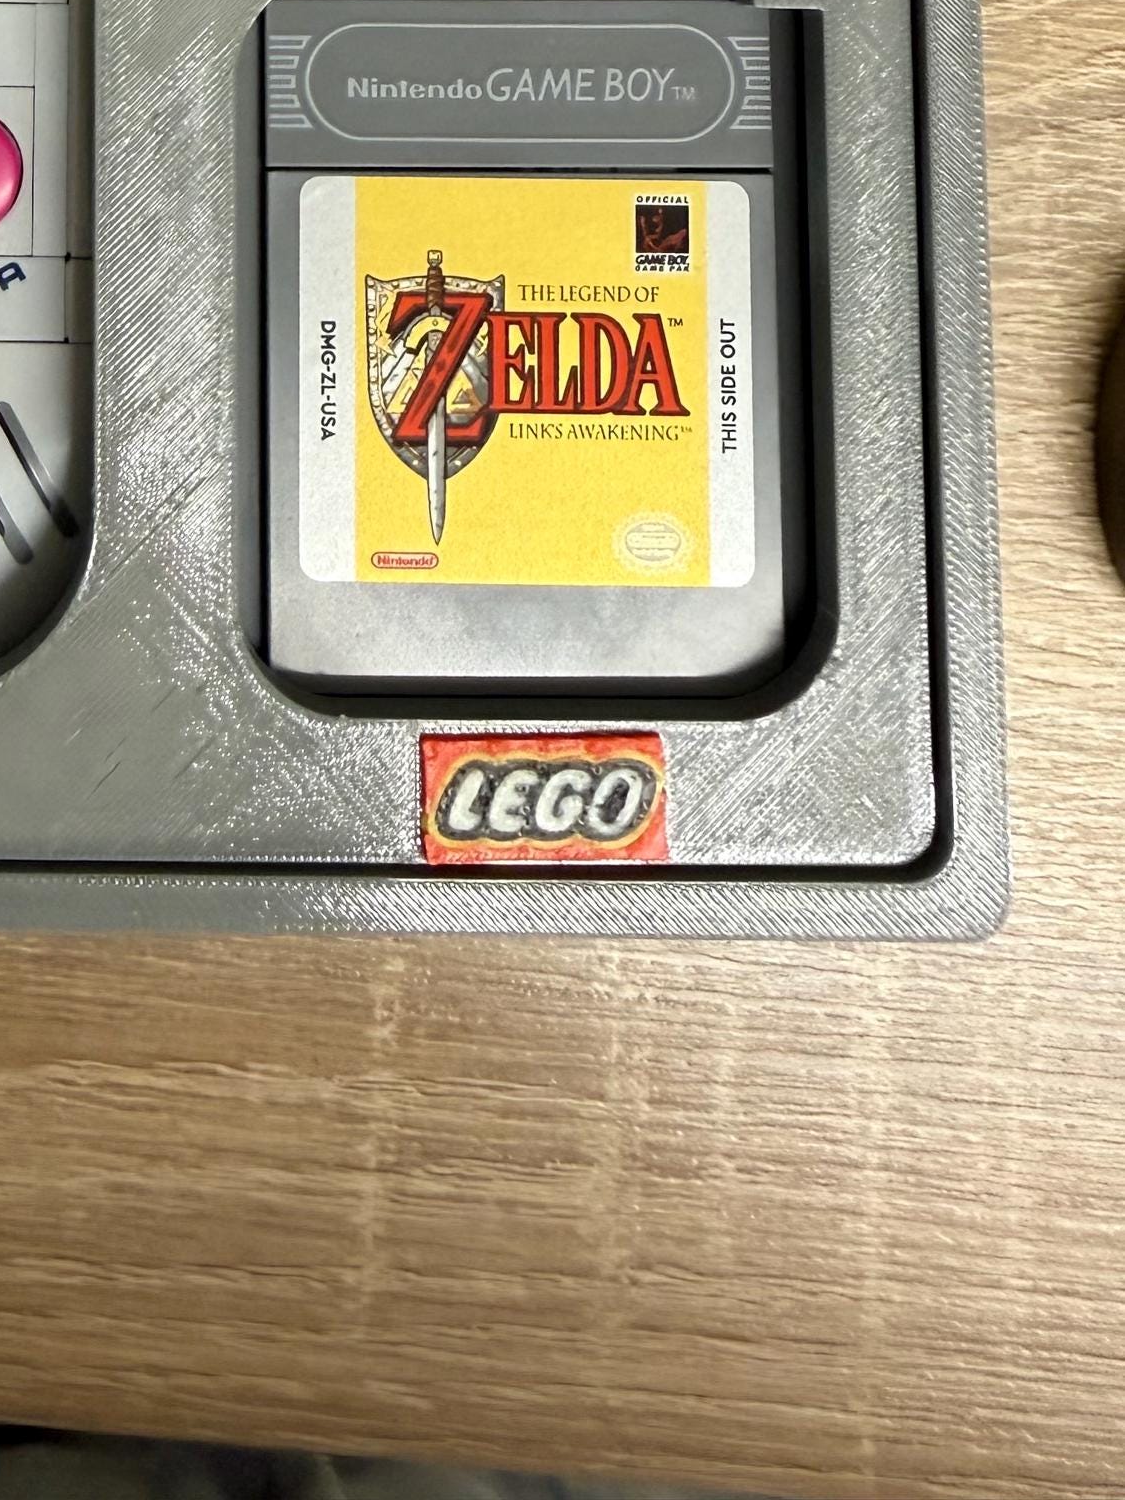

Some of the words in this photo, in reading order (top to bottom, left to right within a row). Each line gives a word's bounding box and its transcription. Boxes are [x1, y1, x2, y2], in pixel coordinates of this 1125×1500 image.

[347, 76, 483, 100] Nintendo
[486, 67, 597, 102] GAME
[636, 195, 689, 204] OFFICIAL
[518, 284, 556, 302] THE
[559, 285, 632, 303] LEGEND
[634, 286, 660, 303] OF
[719, 317, 736, 359] OUT
[320, 320, 337, 441] DMG-ZL-USA
[390, 293, 691, 444] ZELDA
[720, 364, 737, 406] SIDE
[567, 423, 680, 441] AWAKENING
[721, 411, 738, 454] THIS
[447, 767, 644, 836] LEGO
